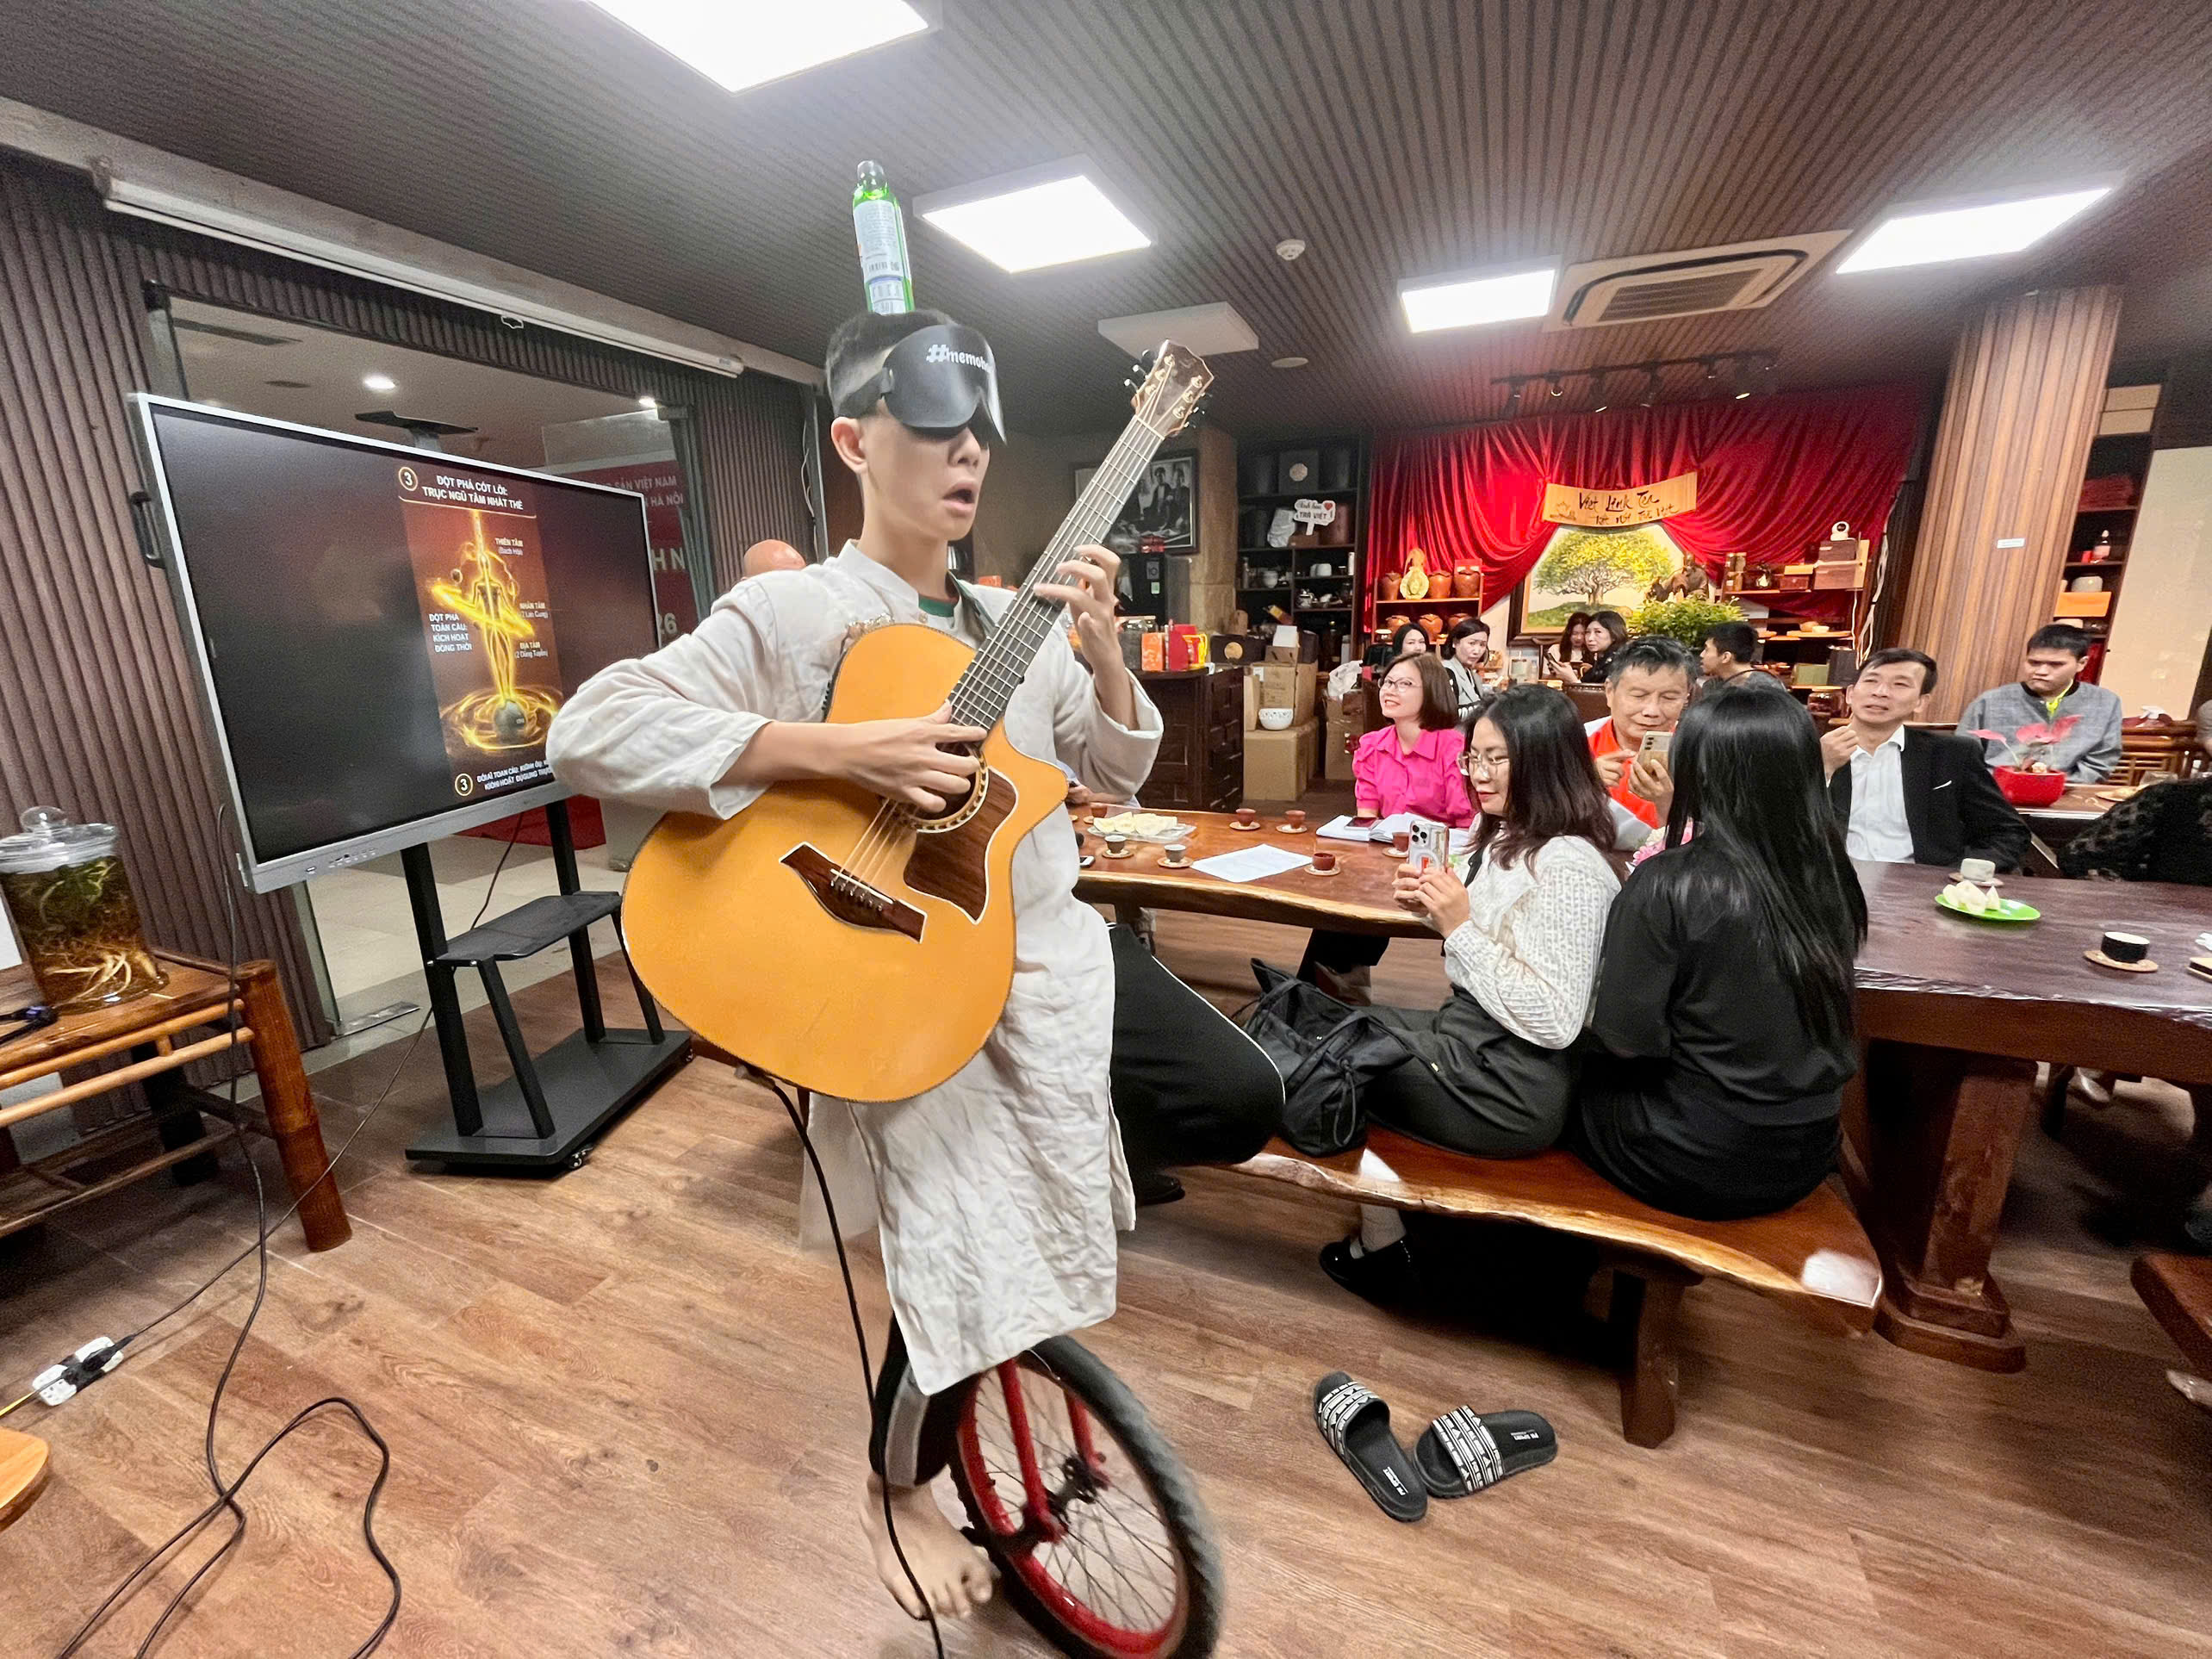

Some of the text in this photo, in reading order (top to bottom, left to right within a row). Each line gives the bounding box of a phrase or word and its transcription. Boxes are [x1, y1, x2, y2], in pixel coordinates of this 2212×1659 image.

[404, 471, 413, 487] 3
[655, 475, 677, 488] NAM
[421, 486, 448, 500] TRỤC
[460, 778, 469, 792] 3
